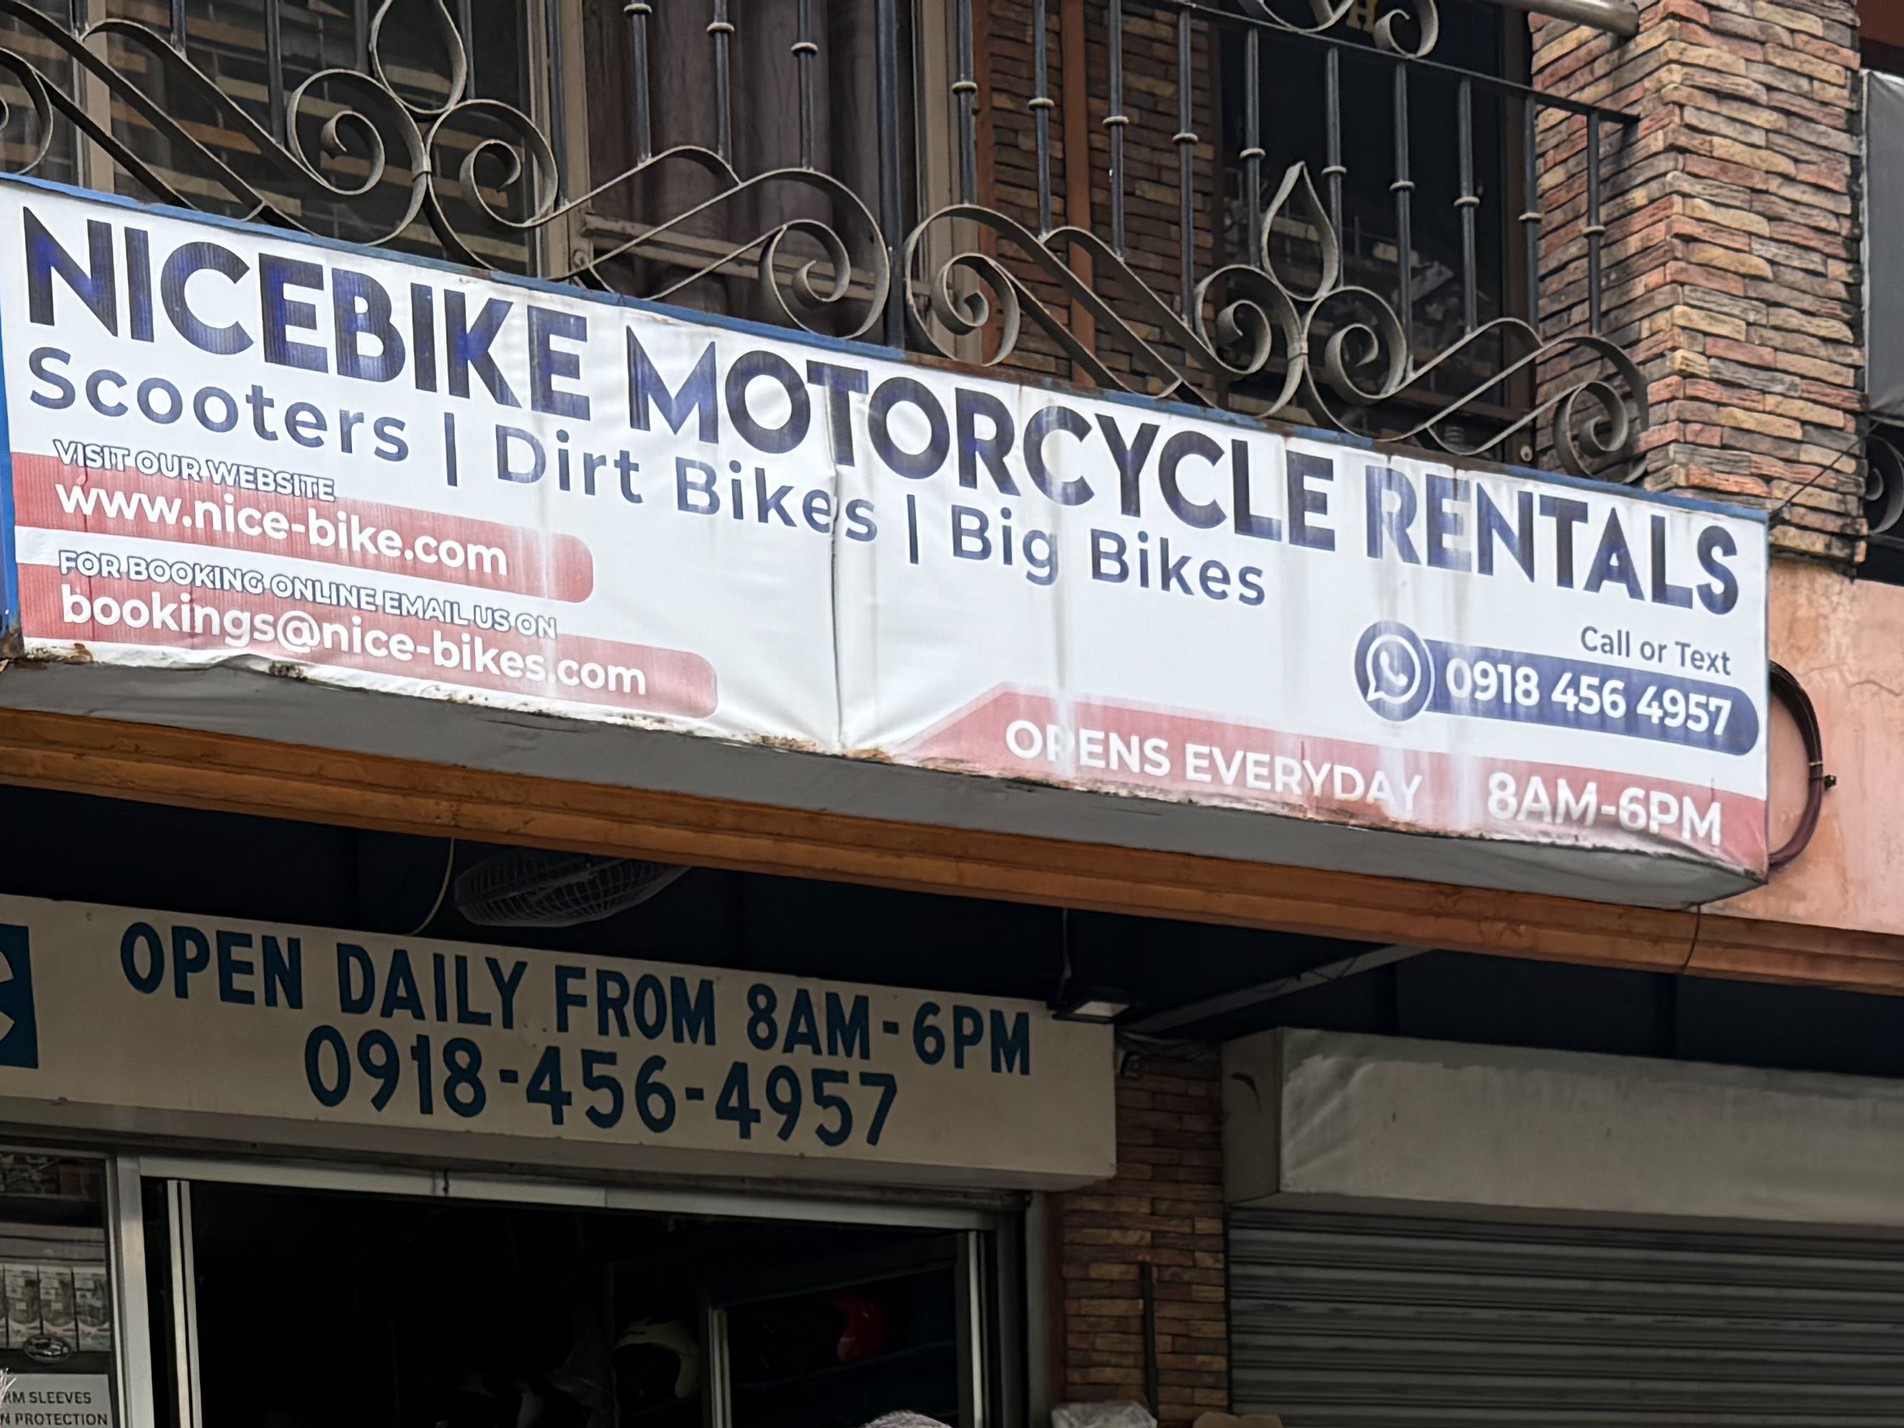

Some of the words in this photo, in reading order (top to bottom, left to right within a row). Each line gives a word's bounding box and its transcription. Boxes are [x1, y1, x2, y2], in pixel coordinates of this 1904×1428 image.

[21, 205, 592, 424] NICEBIKE
[625, 324, 1336, 552] MOTORCYCLE
[1365, 464, 1740, 616] RENTALS
[29, 346, 409, 462] Scooters
[495, 424, 643, 504] Dirt
[676, 457, 877, 543] Bikes
[952, 504, 1058, 587] Big
[1090, 525, 1266, 606] Bikes
[54, 439, 130, 471] VISIT
[136, 447, 202, 482] OUR
[207, 457, 337, 501] WEBSITE
[55, 479, 508, 578] www.nice-bike.com
[58, 550, 122, 580] FOR
[127, 556, 264, 594] BOOKING
[270, 572, 377, 610] ONLINE
[381, 587, 469, 623] EMAIL
[474, 601, 511, 632] US
[515, 609, 558, 640] ON
[60, 583, 646, 696] bookings@nice-bikes.com
[1444, 654, 1540, 708] 0918
[1549, 664, 1627, 721] 456
[1634, 681, 1732, 737] 4957
[1578, 624, 1632, 662] Call
[1639, 640, 1667, 664] or
[1673, 638, 1731, 677] Text
[1005, 717, 1172, 778] OPENS
[1184, 743, 1422, 806] EVERYDAY
[1487, 771, 1721, 847] 8AM-6PM
[119, 920, 304, 1011] OPEN
[336, 941, 528, 1031] DAILY
[554, 963, 718, 1048] FROM
[746, 981, 1031, 1076] 8AM-6PM
[304, 1023, 899, 1148] 0918-456-4957
[3, 1391, 26, 1404] RM
[29, 1391, 93, 1405] SLEEVES
[15, 1412, 109, 1426] PROTECTION
